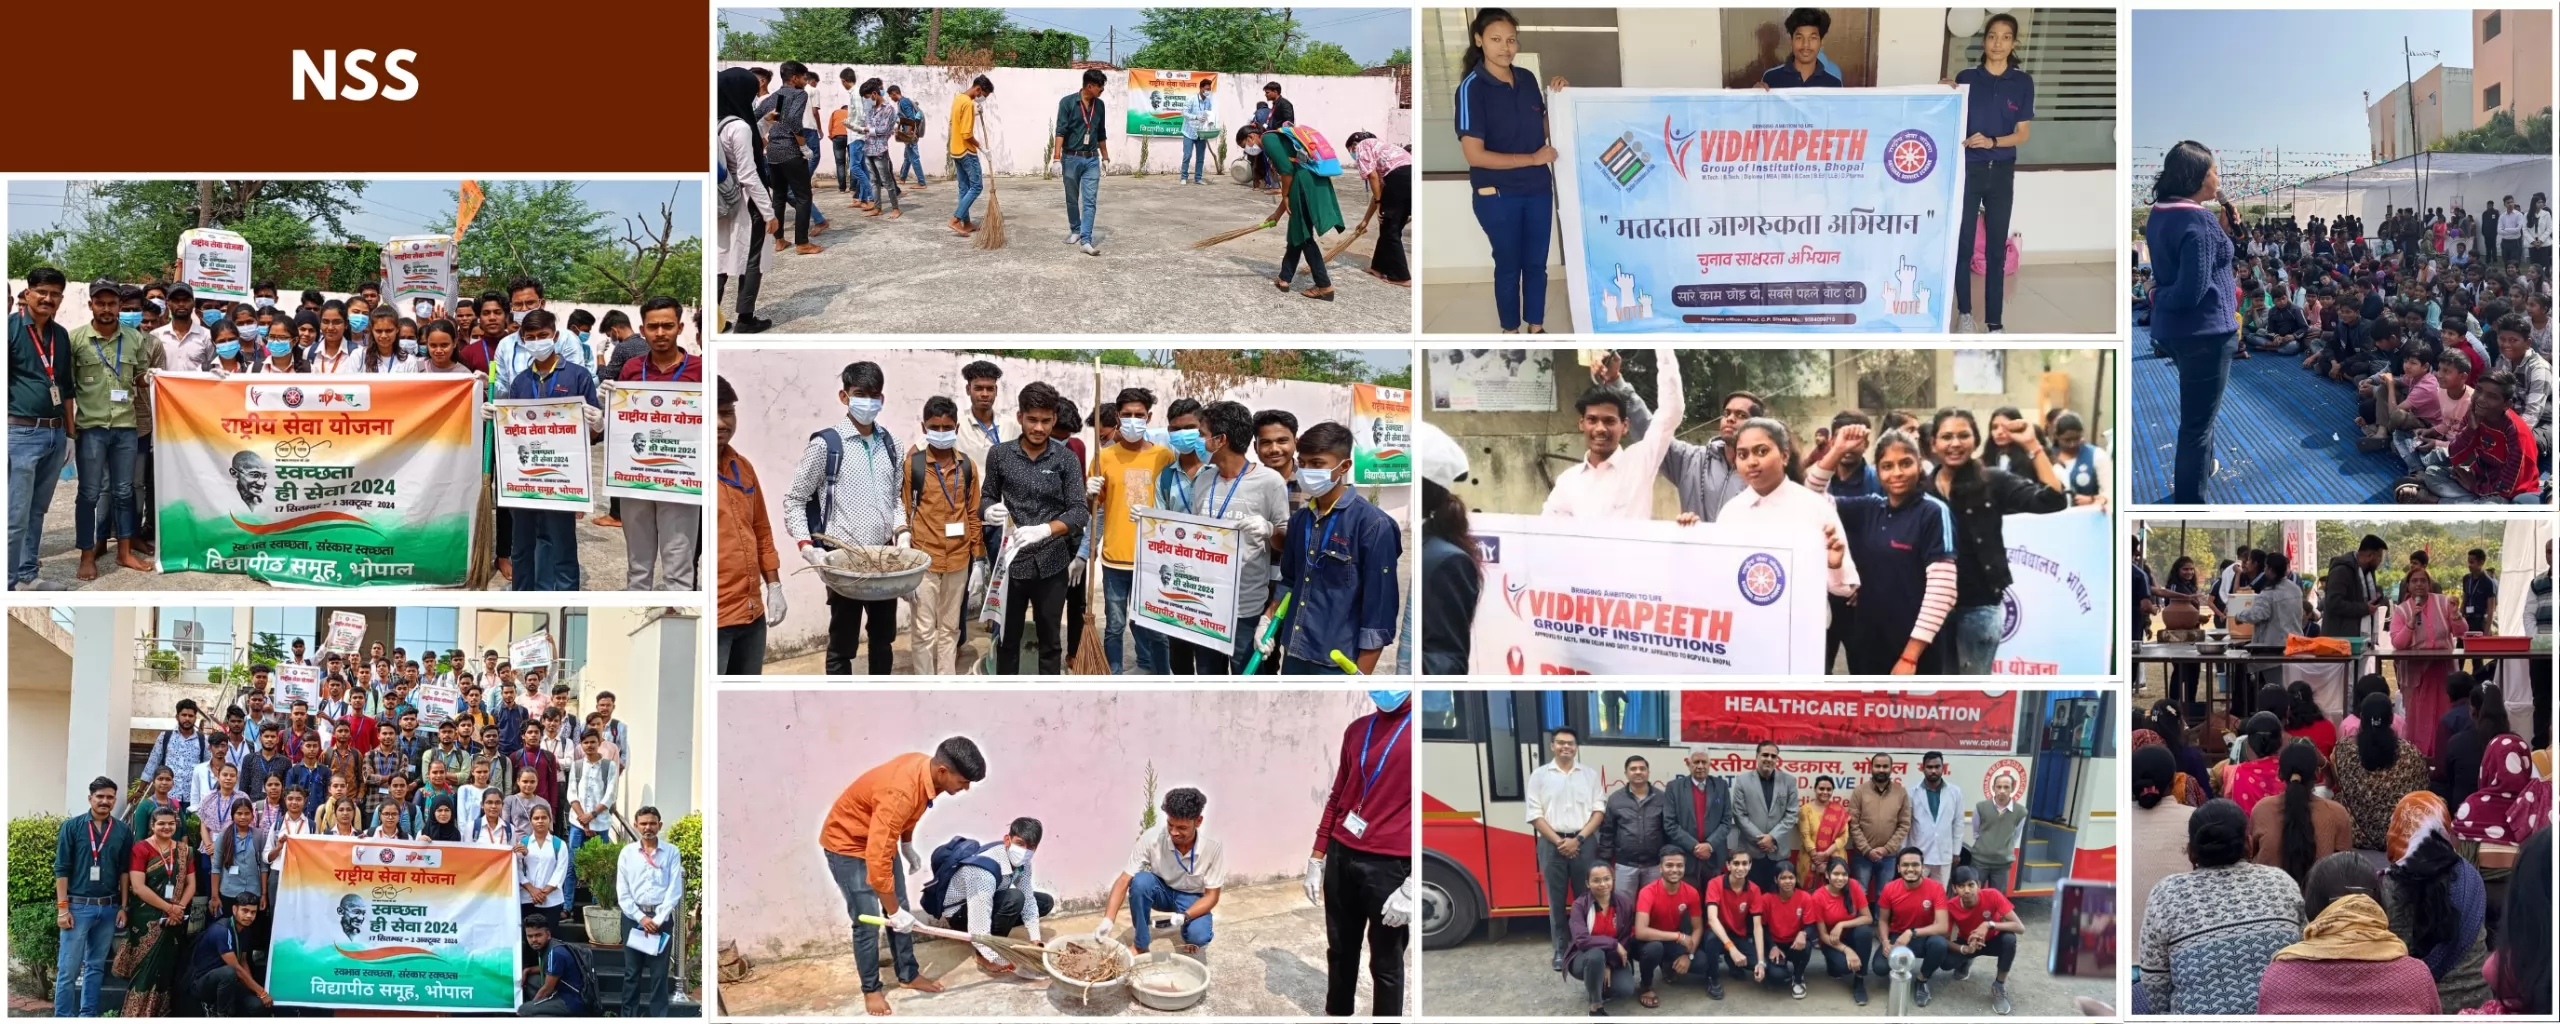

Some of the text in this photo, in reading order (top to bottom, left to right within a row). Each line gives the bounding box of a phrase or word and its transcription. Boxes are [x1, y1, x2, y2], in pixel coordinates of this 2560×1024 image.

[1700, 129, 1868, 163] VIDHYAPEETH
[1701, 162, 1864, 174] Group of Institutions, Bhopal
[1615, 216, 1701, 239] मतदाता
[1827, 207, 1921, 236] अभियान
[1697, 245, 1841, 274] चुनाव साक्षरता अभियान
[1677, 289, 1696, 302] सारे
[1699, 290, 1722, 301] काम
[1768, 286, 1793, 300] सबसे
[1796, 286, 1819, 300] पहले
[1823, 286, 1841, 299] वोट
[1893, 300, 1920, 315] VOTE
[618, 409, 648, 422] राष्ट्रीय
[650, 410, 672, 423] सेवा
[221, 412, 394, 440] राष्ट्रीय सेवा योजना
[504, 423, 577, 437] राष्ट्रीय सेवा योजना
[275, 465, 355, 480] स्वच्छता
[614, 471, 651, 483] विद्यापीठ
[653, 476, 678, 487] समूह,
[681, 477, 702, 488] भोपा
[274, 479, 396, 501] ही सेवा 2024
[559, 485, 583, 495] भोपाल
[377, 501, 395, 509] 2024
[270, 539, 394, 556] स्वच्छता, संस्कार स्वच्छता
[1148, 540, 1229, 564] राष्ट्रीय सेवा योजना
[205, 548, 414, 582] विद्यापीठ समूह, भोपाल
[1198, 583, 1214, 594] 2024
[1145, 601, 1174, 618] विद्यापीठ
[1199, 618, 1226, 633] भोपाल
[1528, 589, 1733, 643] VIDHYAPEETH
[1533, 618, 1727, 655] GROUP OF INSTITUTIONS
[2009, 656, 2058, 675] योजना
[1725, 695, 1980, 722] HEALTHCARE FOUNDATION
[1959, 738, 2009, 748] www.cphd.in
[335, 866, 456, 887] राष्ट्रीय सेवा योजना
[371, 904, 428, 916] स्वच्छता
[370, 916, 458, 934] ही सेवा 2024
[310, 976, 474, 1002] विद्यापीठ समूह, भोपाल
